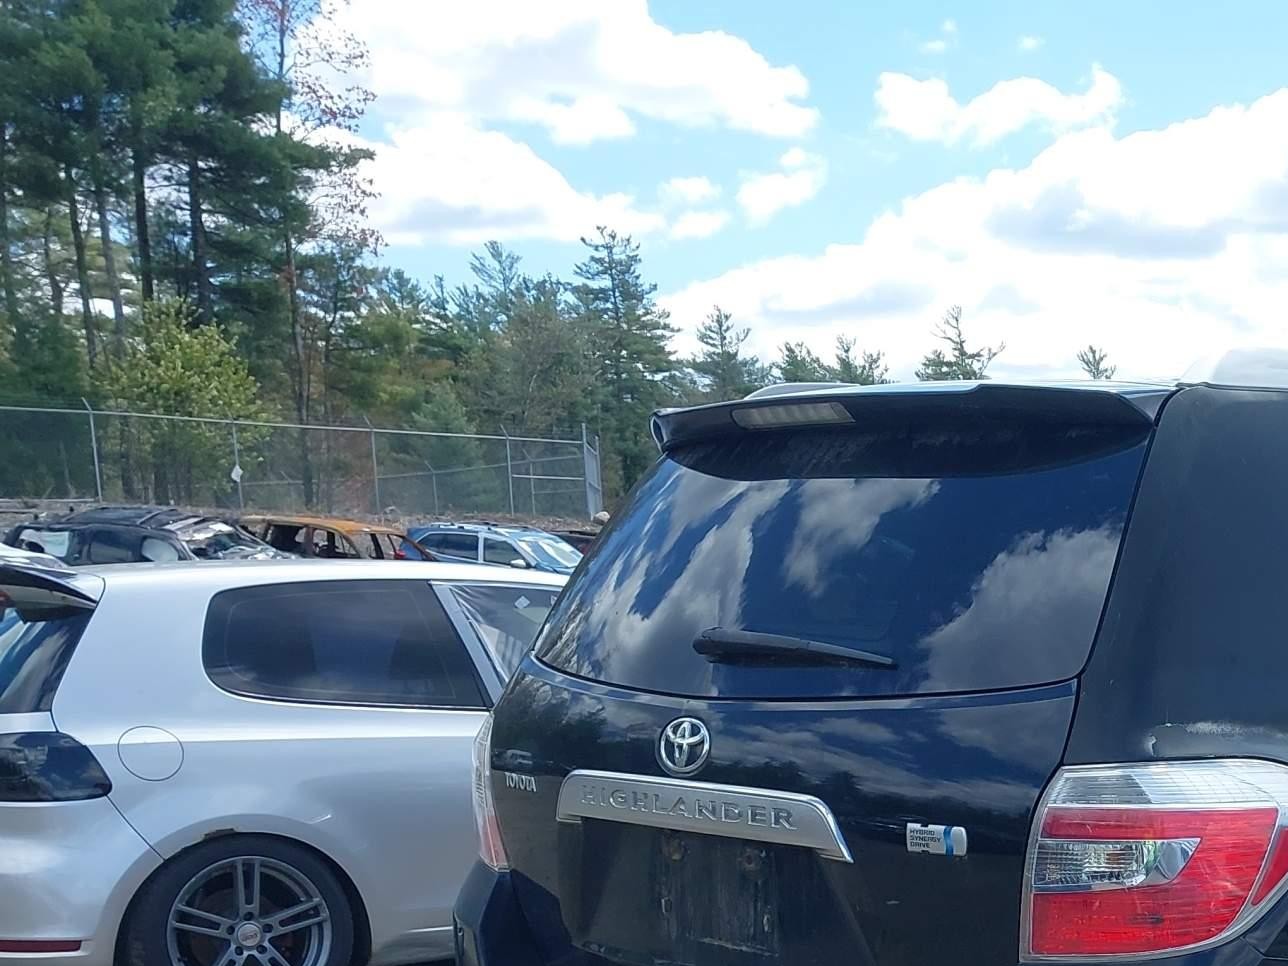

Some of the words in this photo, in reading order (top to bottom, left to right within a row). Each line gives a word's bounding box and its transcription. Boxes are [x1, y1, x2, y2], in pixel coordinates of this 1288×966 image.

[504, 771, 537, 792] TOYOTA
[580, 784, 798, 830] HIGHLANDER
[909, 835, 941, 843] SYNERGY
[910, 841, 931, 849] DRIVE
